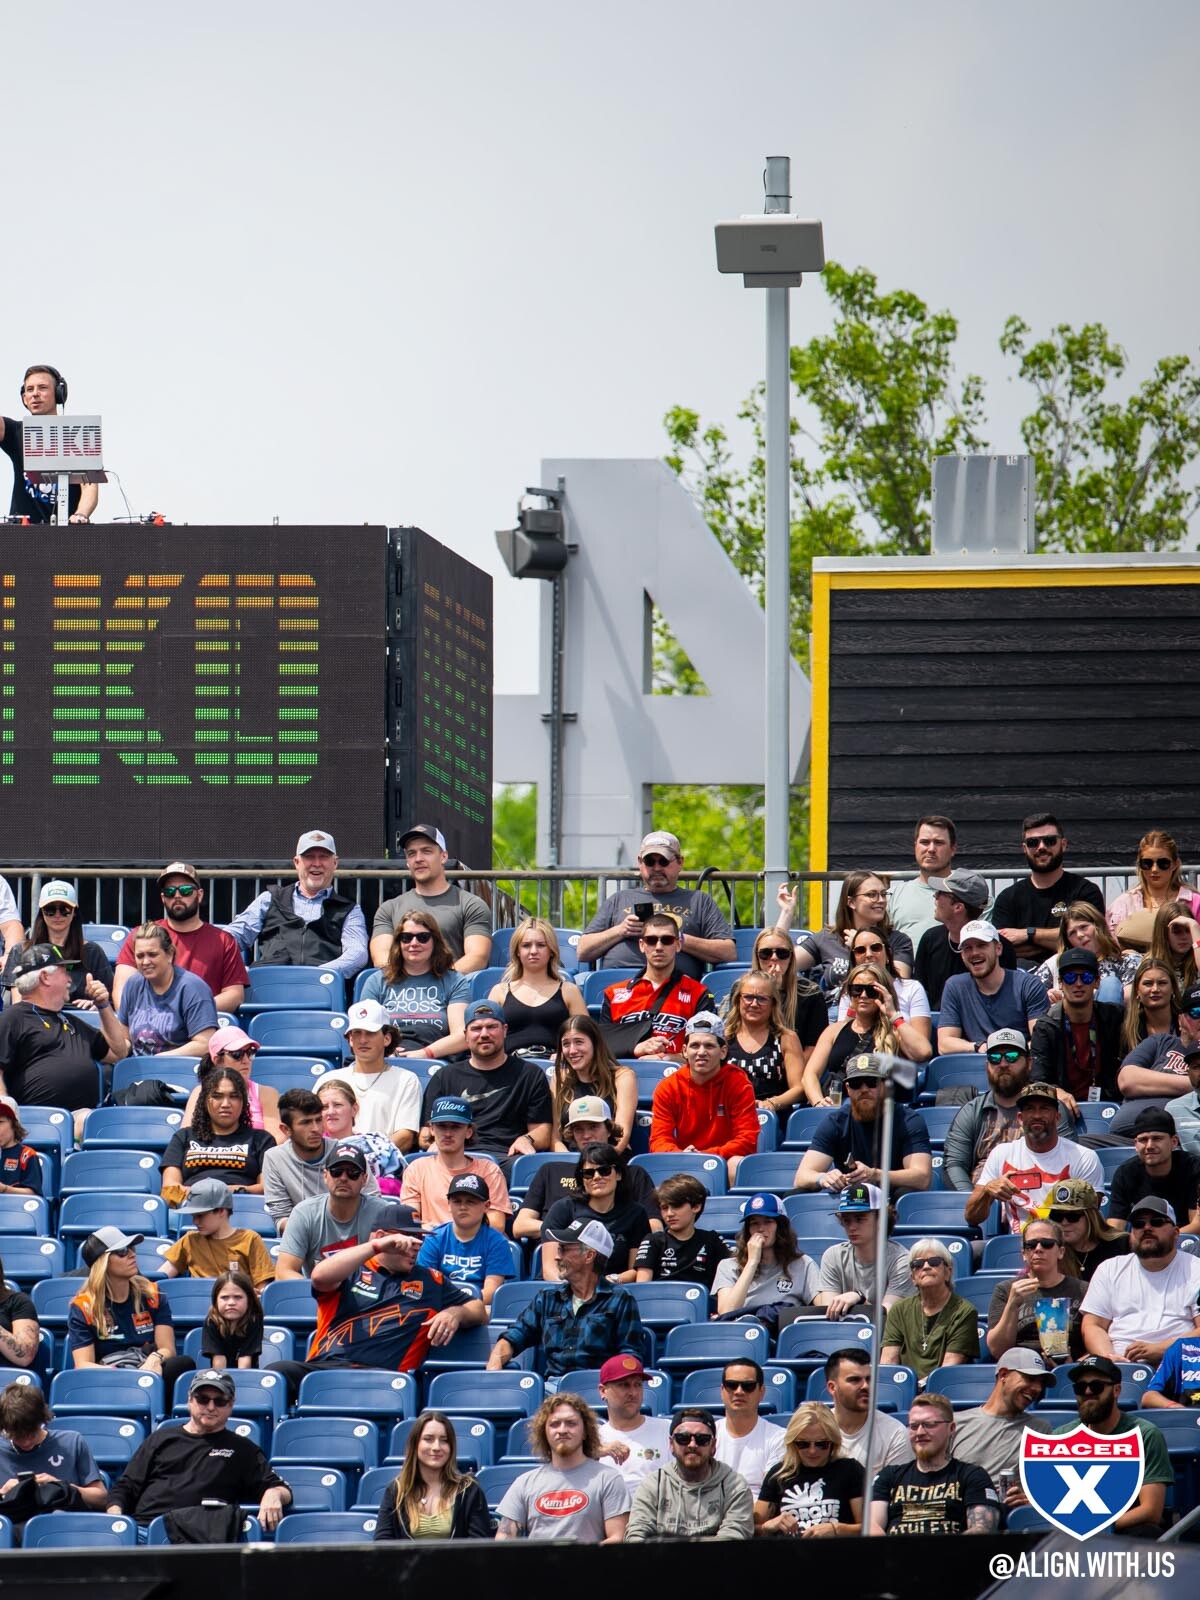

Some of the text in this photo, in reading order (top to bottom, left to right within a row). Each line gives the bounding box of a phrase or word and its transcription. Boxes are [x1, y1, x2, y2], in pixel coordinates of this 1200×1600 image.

[624, 904, 693, 918] VTAGE
[389, 986, 438, 1000] MOTO
[386, 1000, 441, 1013] CROSS
[436, 1100, 467, 1112] Titans
[443, 1254, 482, 1268] RIDE
[781, 1504, 840, 1522] ORQUE
